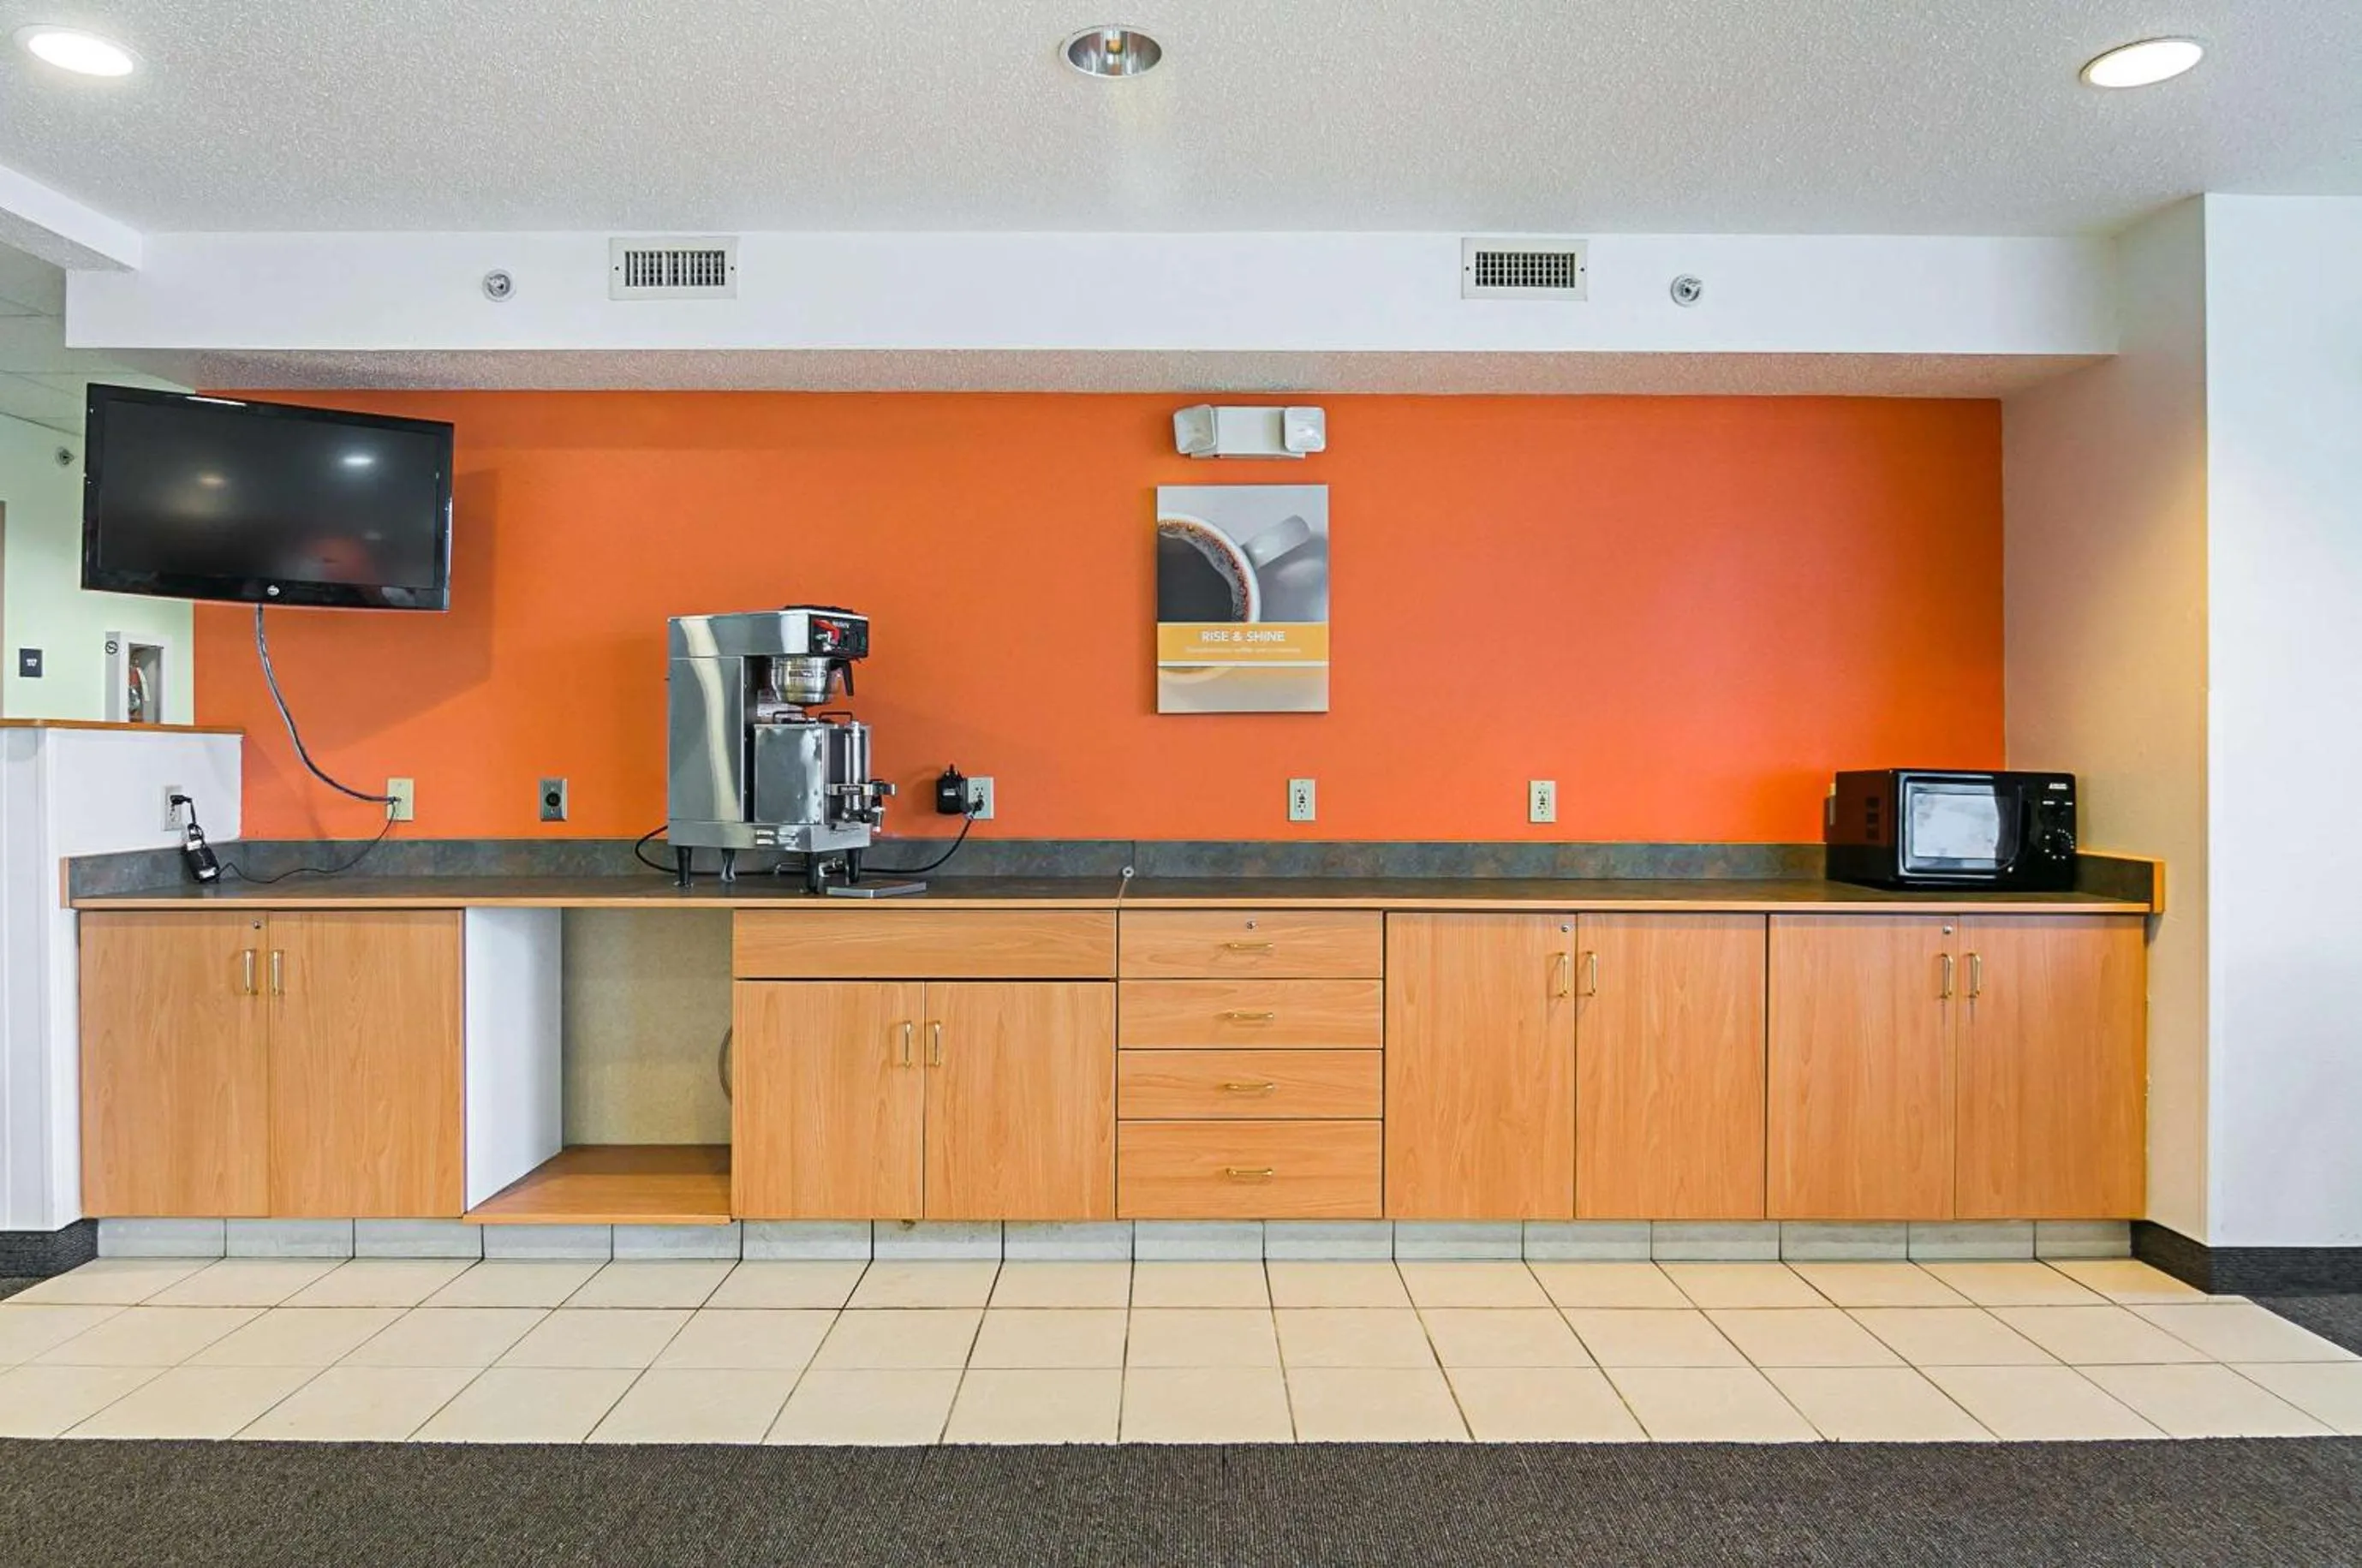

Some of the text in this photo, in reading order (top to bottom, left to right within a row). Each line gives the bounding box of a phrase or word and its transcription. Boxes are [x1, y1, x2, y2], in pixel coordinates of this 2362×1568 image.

[1202, 631, 1285, 641] RISE & SHINE
